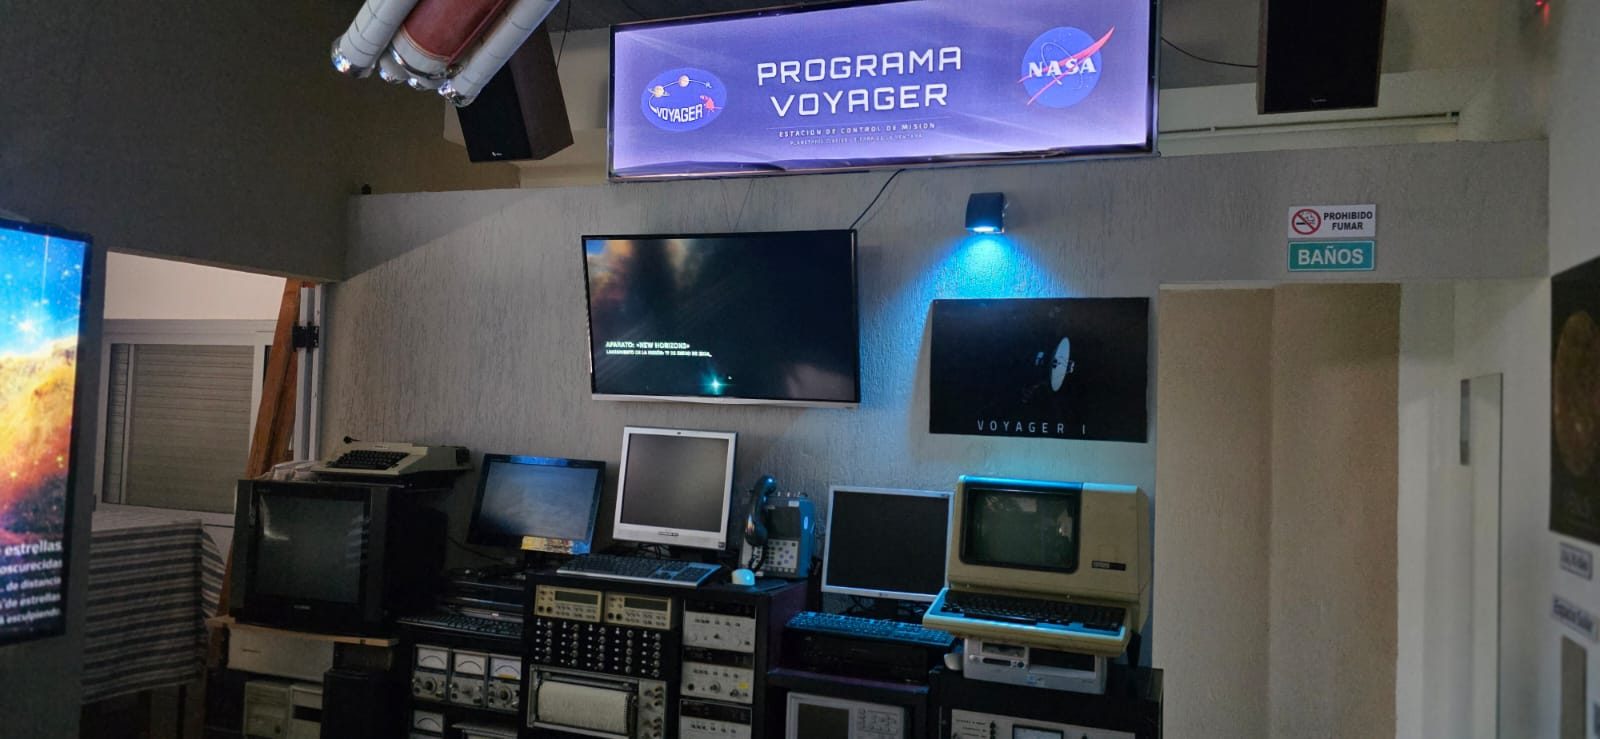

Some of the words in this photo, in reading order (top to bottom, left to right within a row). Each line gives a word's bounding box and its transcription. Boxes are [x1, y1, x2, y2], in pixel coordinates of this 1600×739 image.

[757, 46, 961, 86] PROGRAMA
[1028, 56, 1097, 78] NASA
[770, 83, 948, 117] VOYAGER
[656, 103, 703, 123] VOYAGER
[840, 126, 881, 134] CONTROL
[1323, 211, 1373, 221] PROHIBIDO
[1332, 222, 1363, 230] FUMAR
[1298, 245, 1364, 265] BAÑOS
[977, 419, 1065, 434] VOYAGER
[1081, 424, 1086, 435] I
[4, 540, 62, 556] estrellas
[5, 598, 18, 609] de
